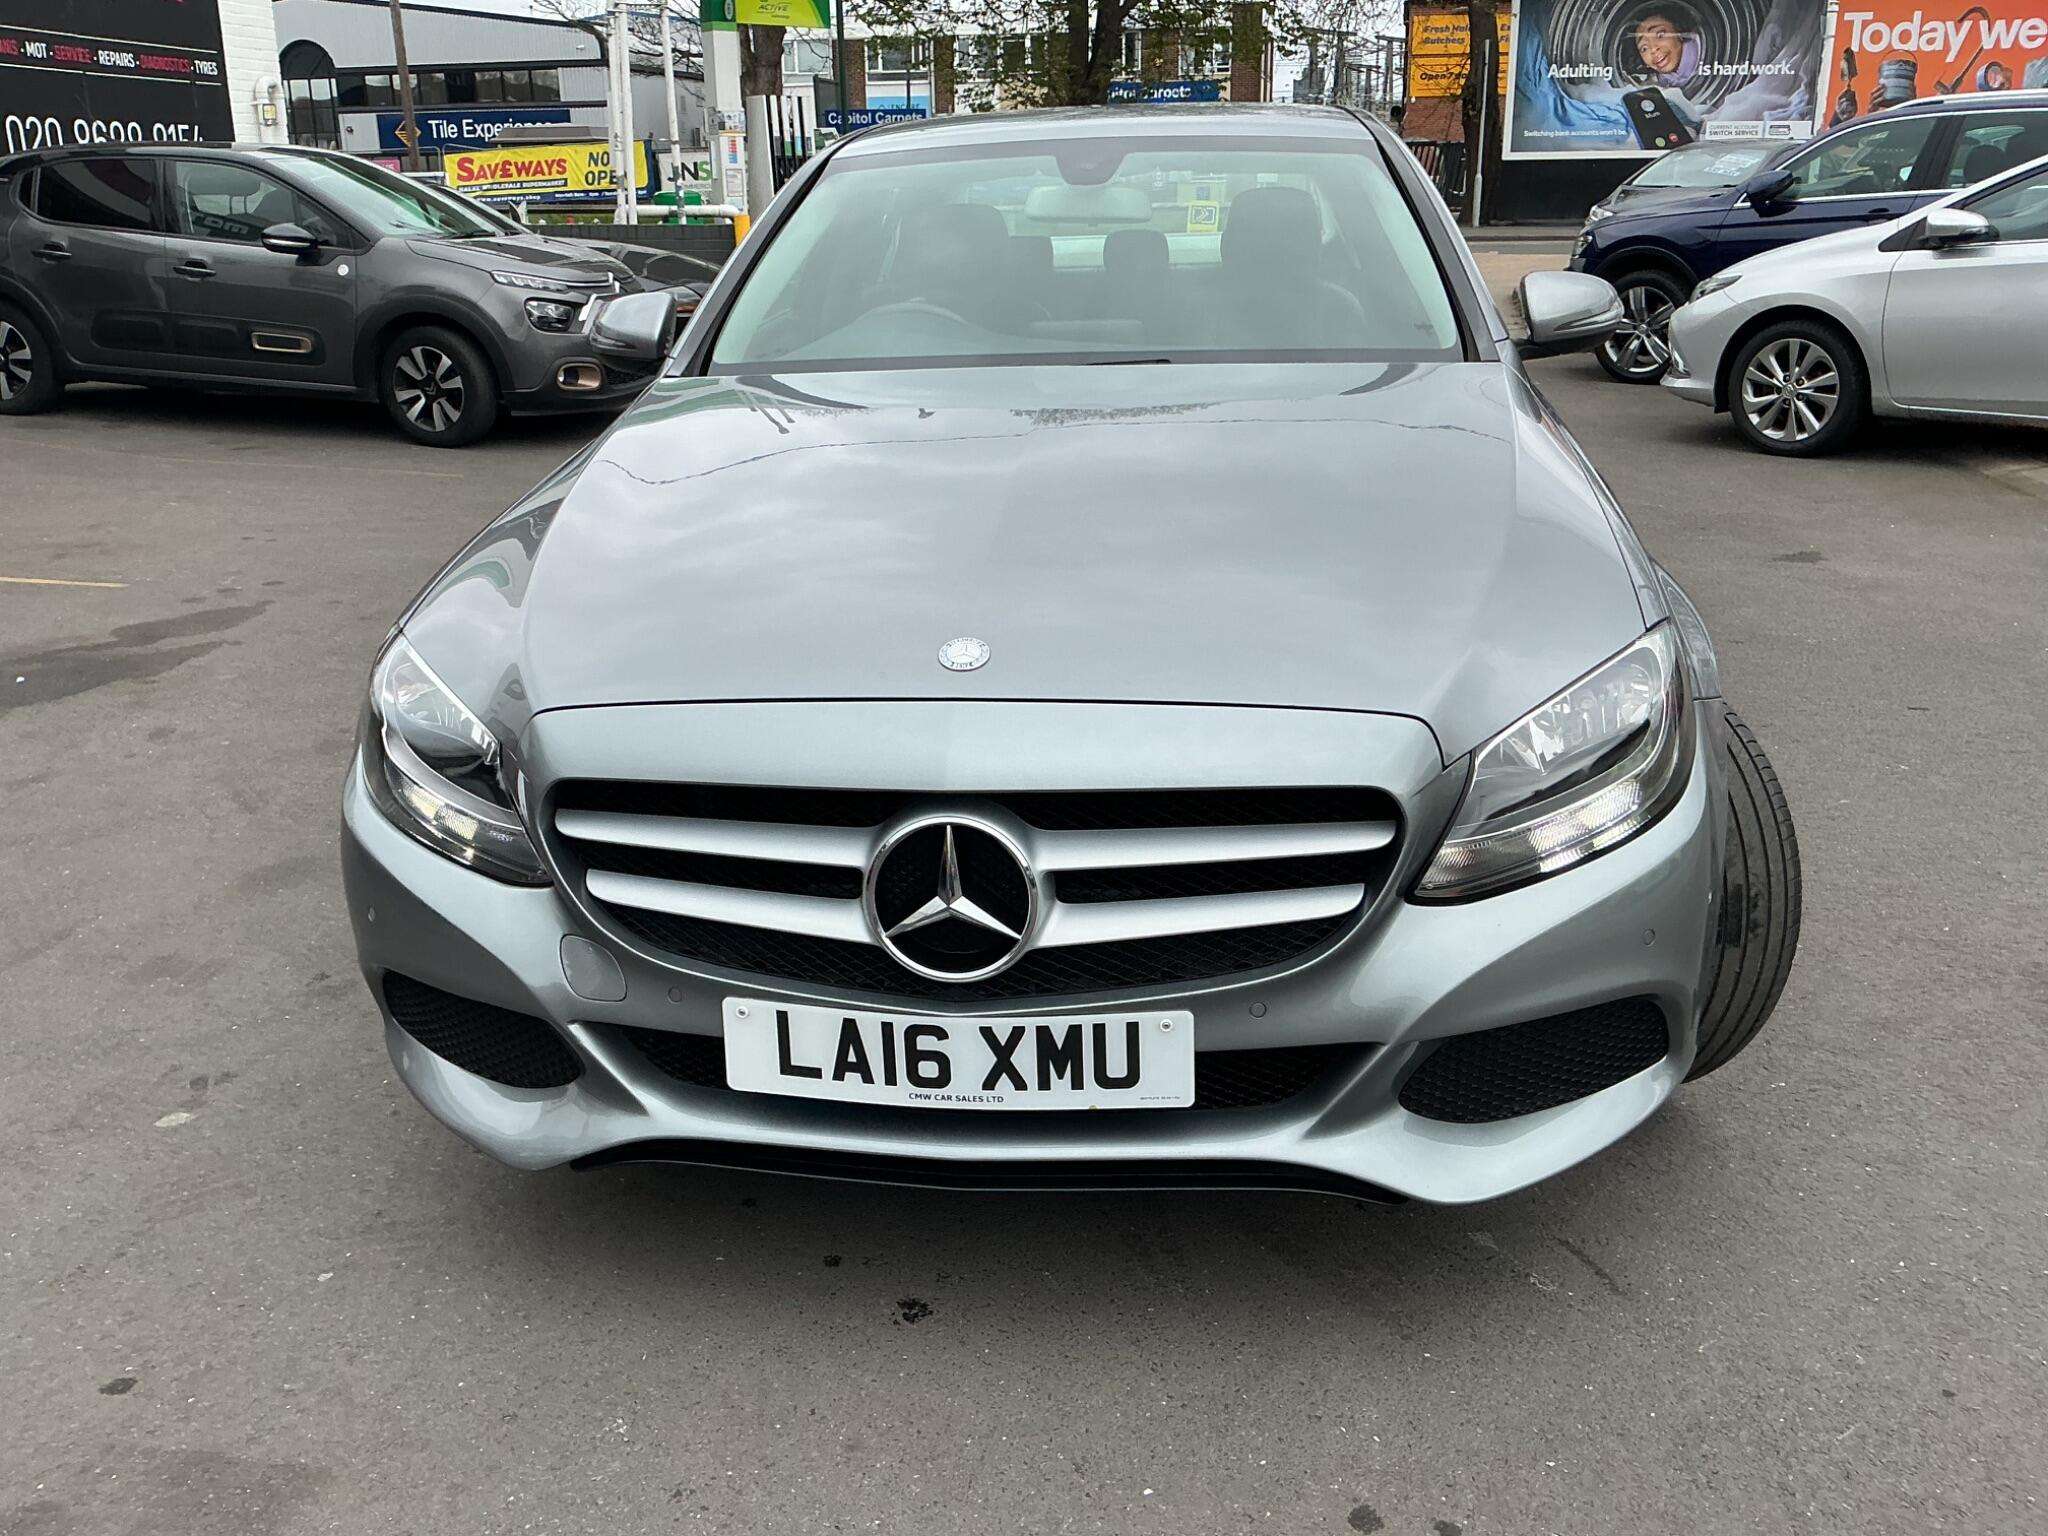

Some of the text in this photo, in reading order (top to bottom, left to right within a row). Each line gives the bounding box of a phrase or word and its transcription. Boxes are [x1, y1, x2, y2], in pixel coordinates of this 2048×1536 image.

[1423, 24, 1450, 33] Fresh
[1844, 10, 2048, 63] Today we
[25, 41, 47, 59] MOT
[54, 45, 92, 64] SERVICE
[98, 50, 135, 69] REPAIRS
[140, 54, 190, 73] DIAGNOSTICS
[193, 60, 218, 76] TYRES
[1548, 63, 1613, 81] Adulting
[1698, 60, 1795, 76] is hard work.
[1420, 72, 1446, 82] Open
[427, 118, 553, 142] Tile Experi
[1524, 130, 1554, 138] Switching
[585, 169, 628, 186] OPE
[776, 1009, 1140, 1091] LA16 XMU
[908, 1093, 932, 1101] CMW
[934, 1094, 954, 1102] CAR
[955, 1095, 985, 1103] SALES
